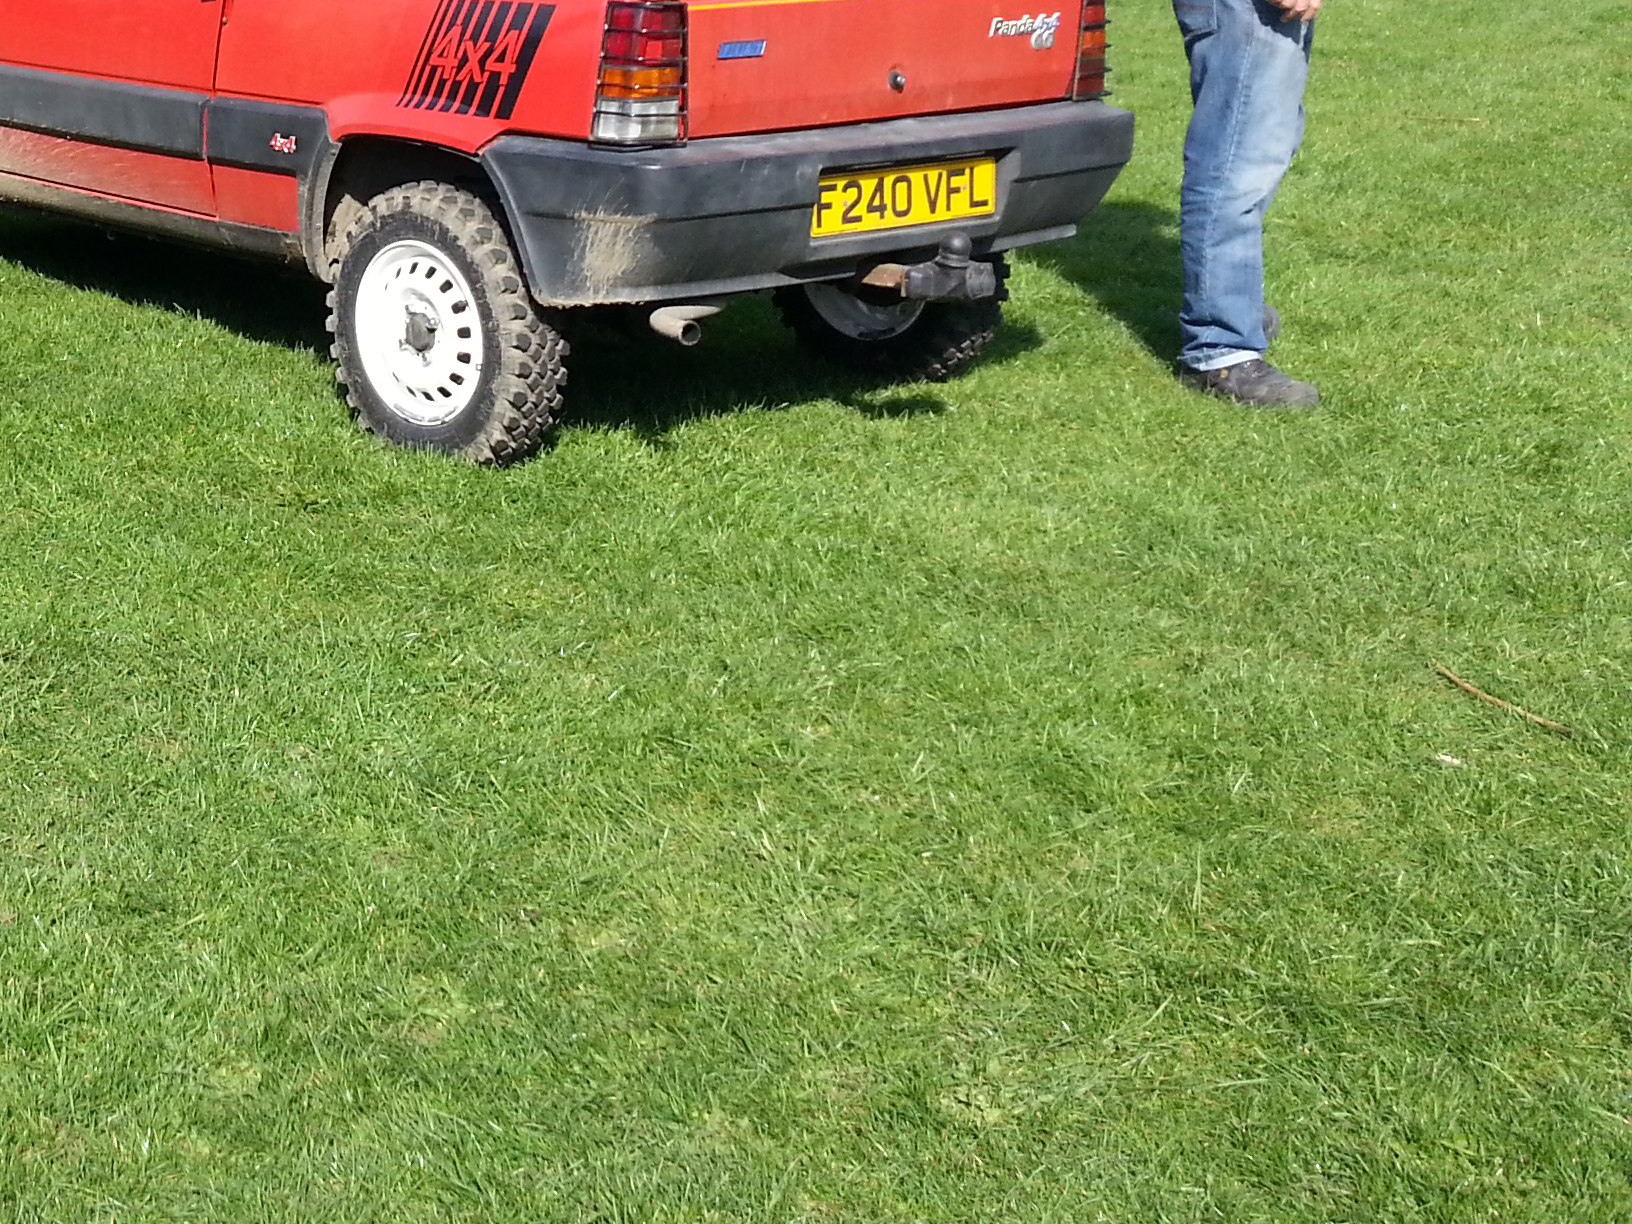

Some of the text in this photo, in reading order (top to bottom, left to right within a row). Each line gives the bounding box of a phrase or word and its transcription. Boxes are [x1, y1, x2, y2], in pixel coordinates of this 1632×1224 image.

[989, 14, 1035, 37] Panda
[428, 24, 520, 87] 4x4
[269, 132, 297, 153] 4x4
[817, 167, 989, 229] F240 VFL
